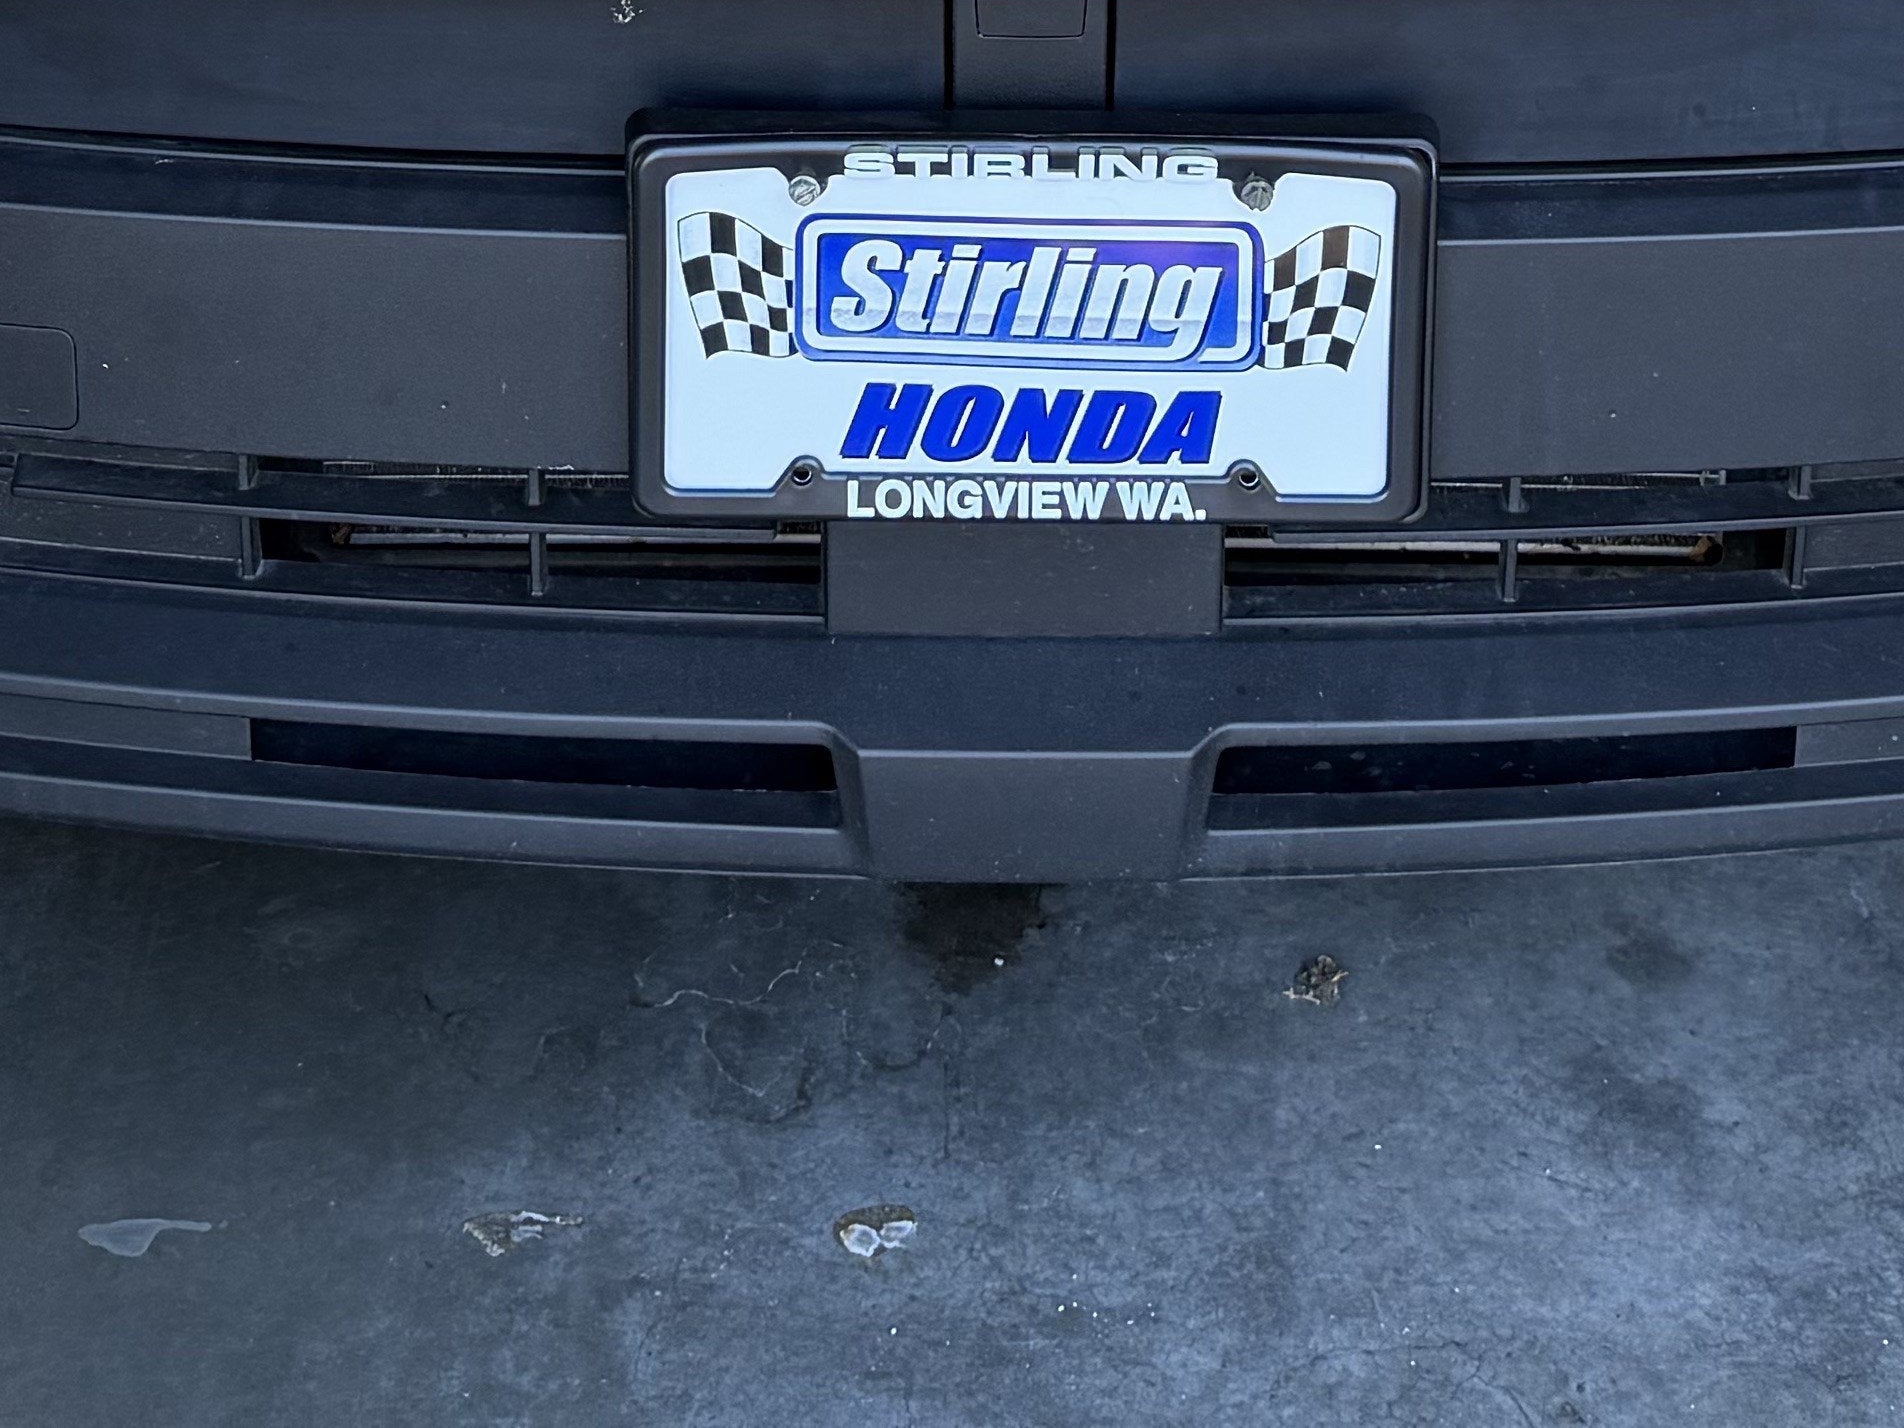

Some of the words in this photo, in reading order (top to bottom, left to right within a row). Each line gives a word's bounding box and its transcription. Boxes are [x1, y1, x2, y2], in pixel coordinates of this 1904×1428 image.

[843, 146, 1219, 181] STIRLING
[830, 239, 1224, 361] Stirling
[840, 381, 1222, 464] HONDA
[847, 479, 1110, 520] LONGVIEW
[1115, 480, 1207, 521] WA.
